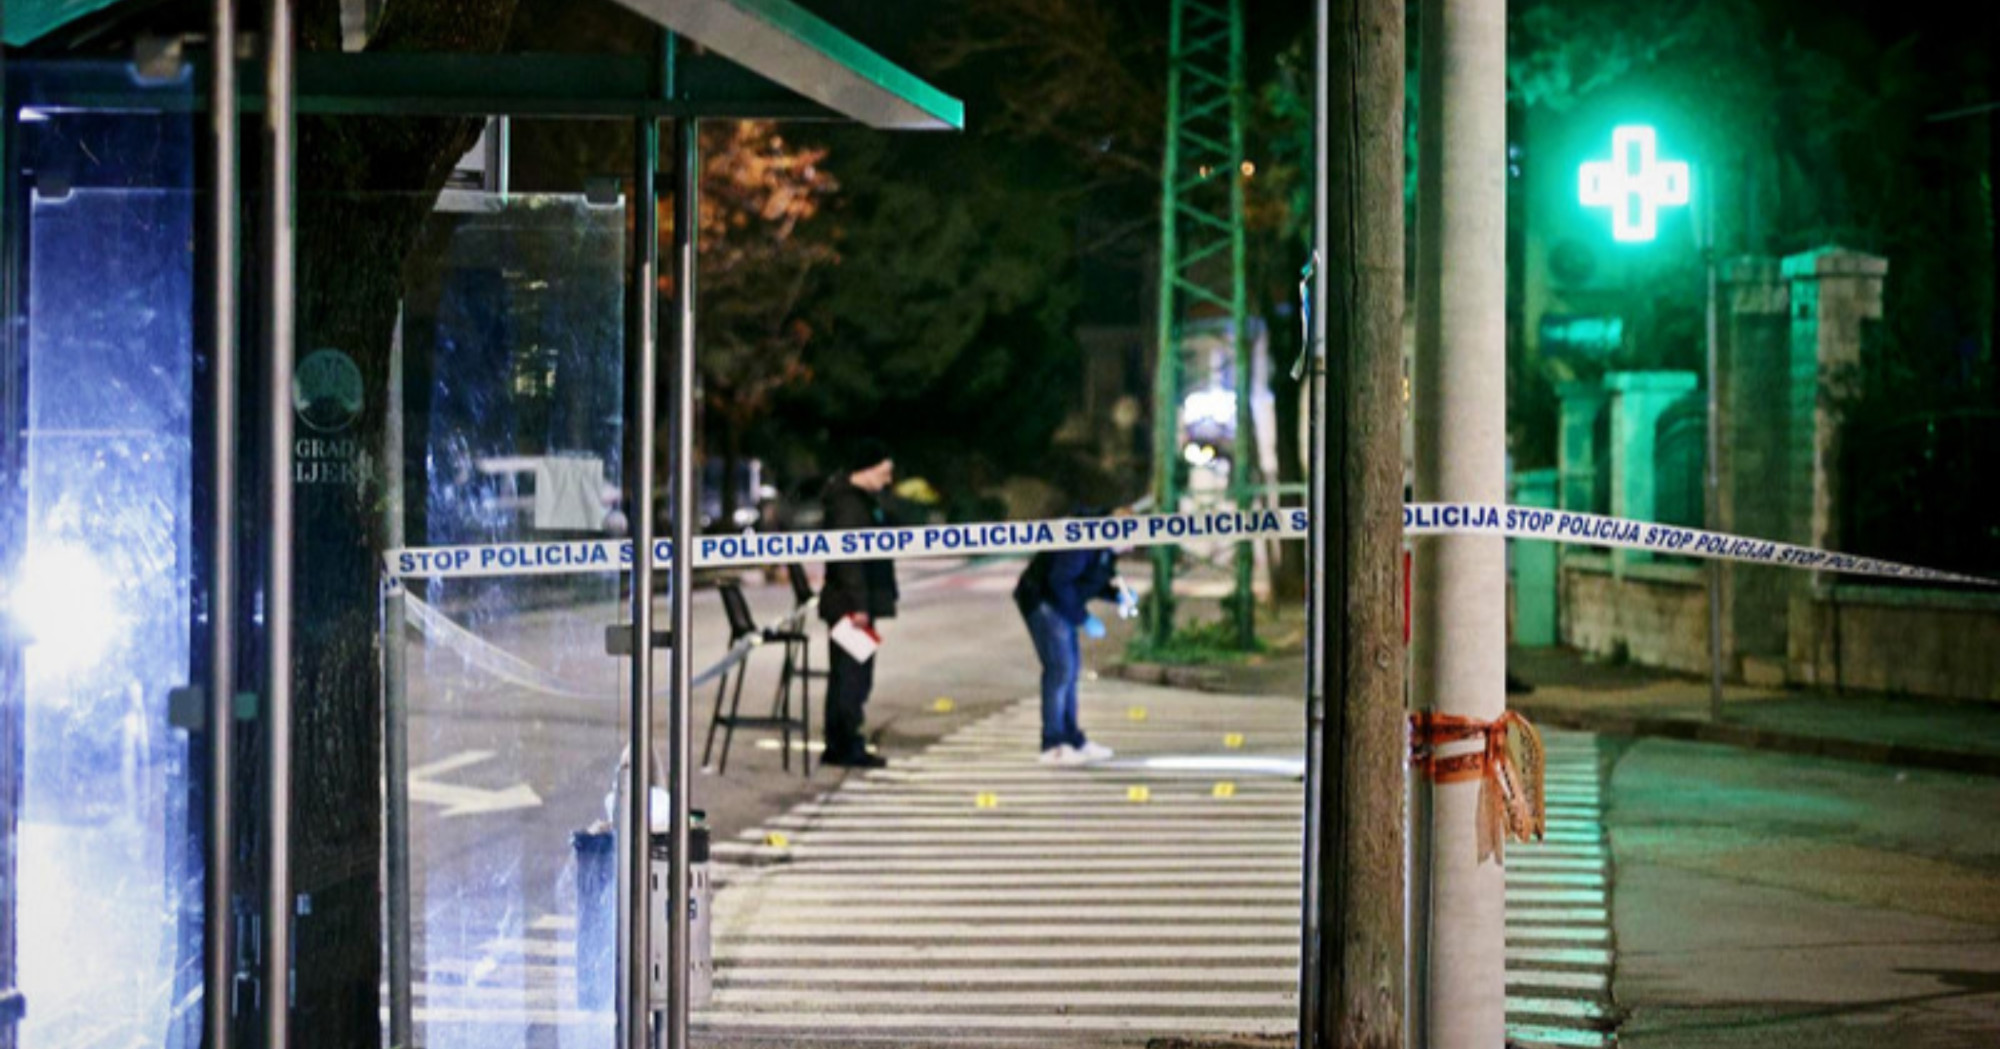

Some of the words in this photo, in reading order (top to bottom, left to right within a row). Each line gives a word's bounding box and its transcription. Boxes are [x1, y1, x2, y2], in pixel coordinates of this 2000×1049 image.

[296, 439, 354, 458] GRAD
[400, 551, 469, 573] STOP
[481, 543, 608, 568] POLICIJA
[619, 540, 674, 563] SO
[701, 530, 830, 560] POLICIJA
[841, 530, 914, 553] STOP
[924, 523, 1054, 549] POLICIJA
[1064, 518, 1138, 542] STOP
[1149, 511, 1280, 538] POLICIJA
[1402, 506, 1499, 528] OLICIJA
[1505, 508, 1554, 532] STOP
[1557, 514, 1641, 543] POLICIJA
[1644, 526, 1694, 549] STOP
[1694, 533, 1776, 561] POLICIJA
